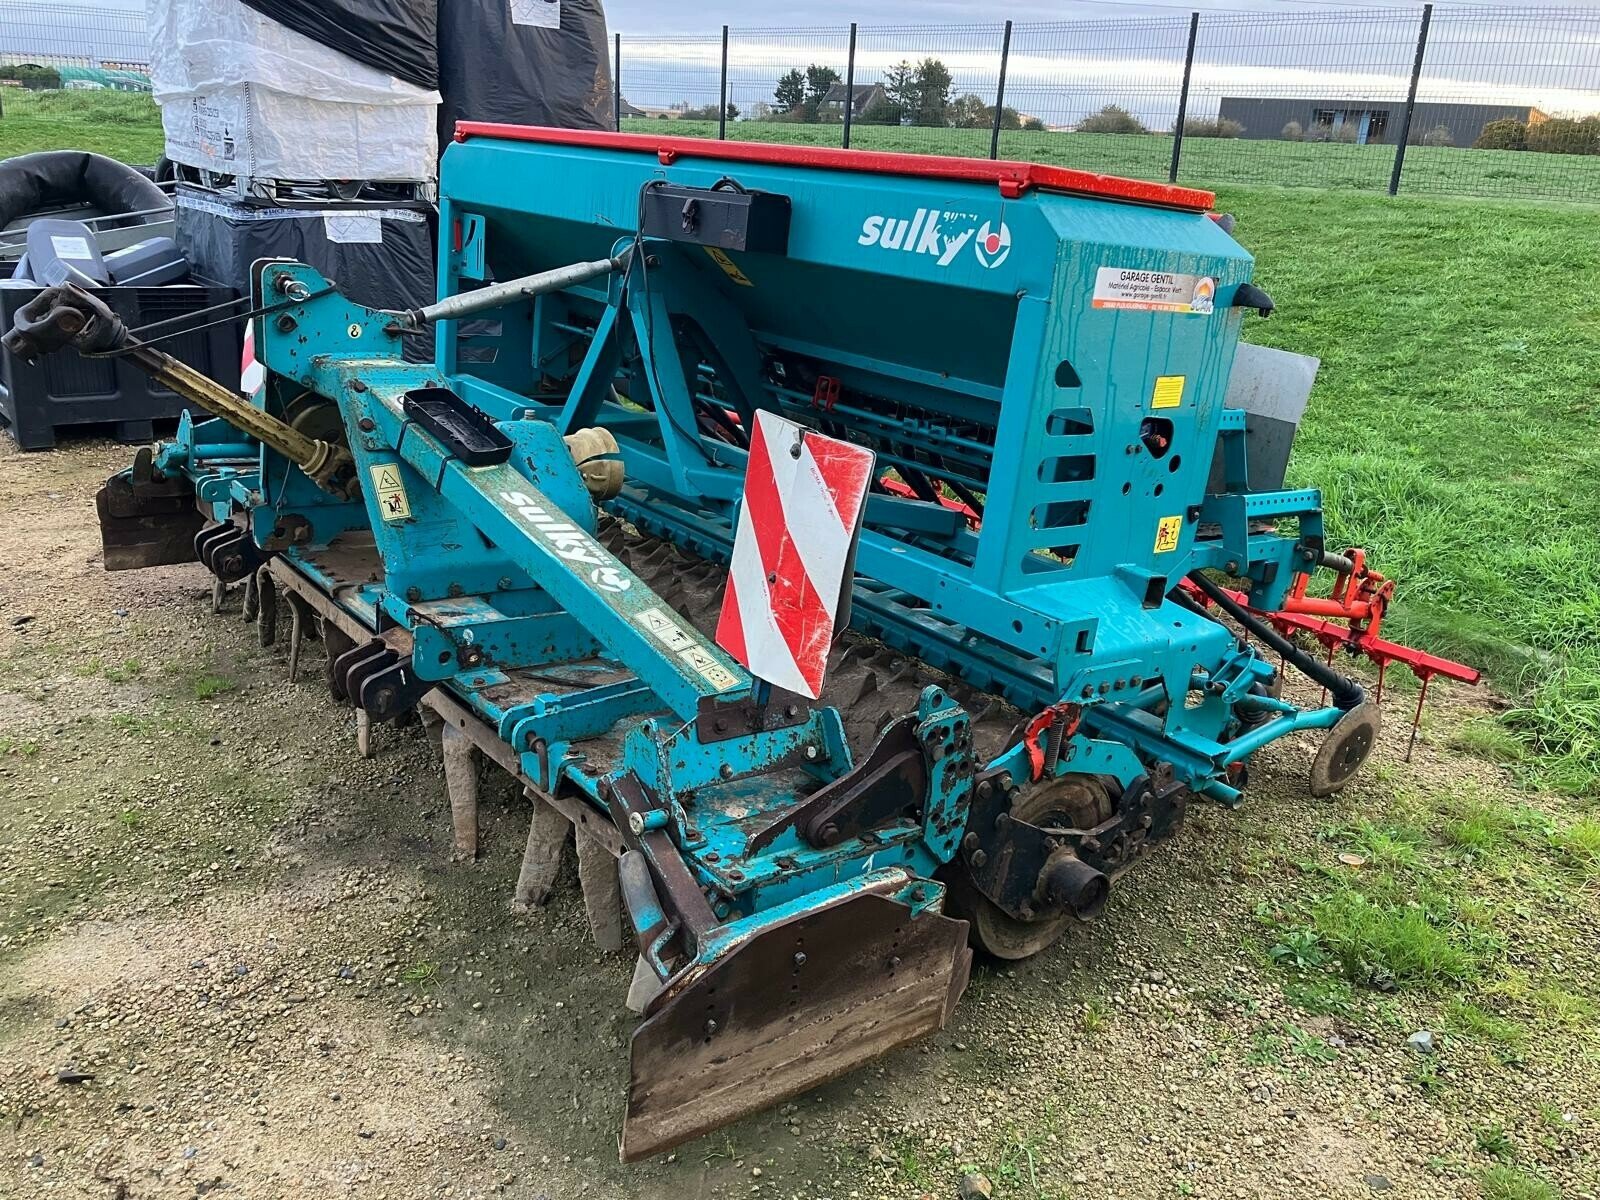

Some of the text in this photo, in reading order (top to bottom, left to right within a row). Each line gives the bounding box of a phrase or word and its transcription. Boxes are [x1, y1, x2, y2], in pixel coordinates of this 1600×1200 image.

[858, 208, 975, 266] sulky
[1120, 271, 1174, 285] GARAGE GENTIL
[1154, 284, 1171, 293] Espace
[1172, 286, 1182, 294] Vert
[499, 492, 605, 566] sulky
